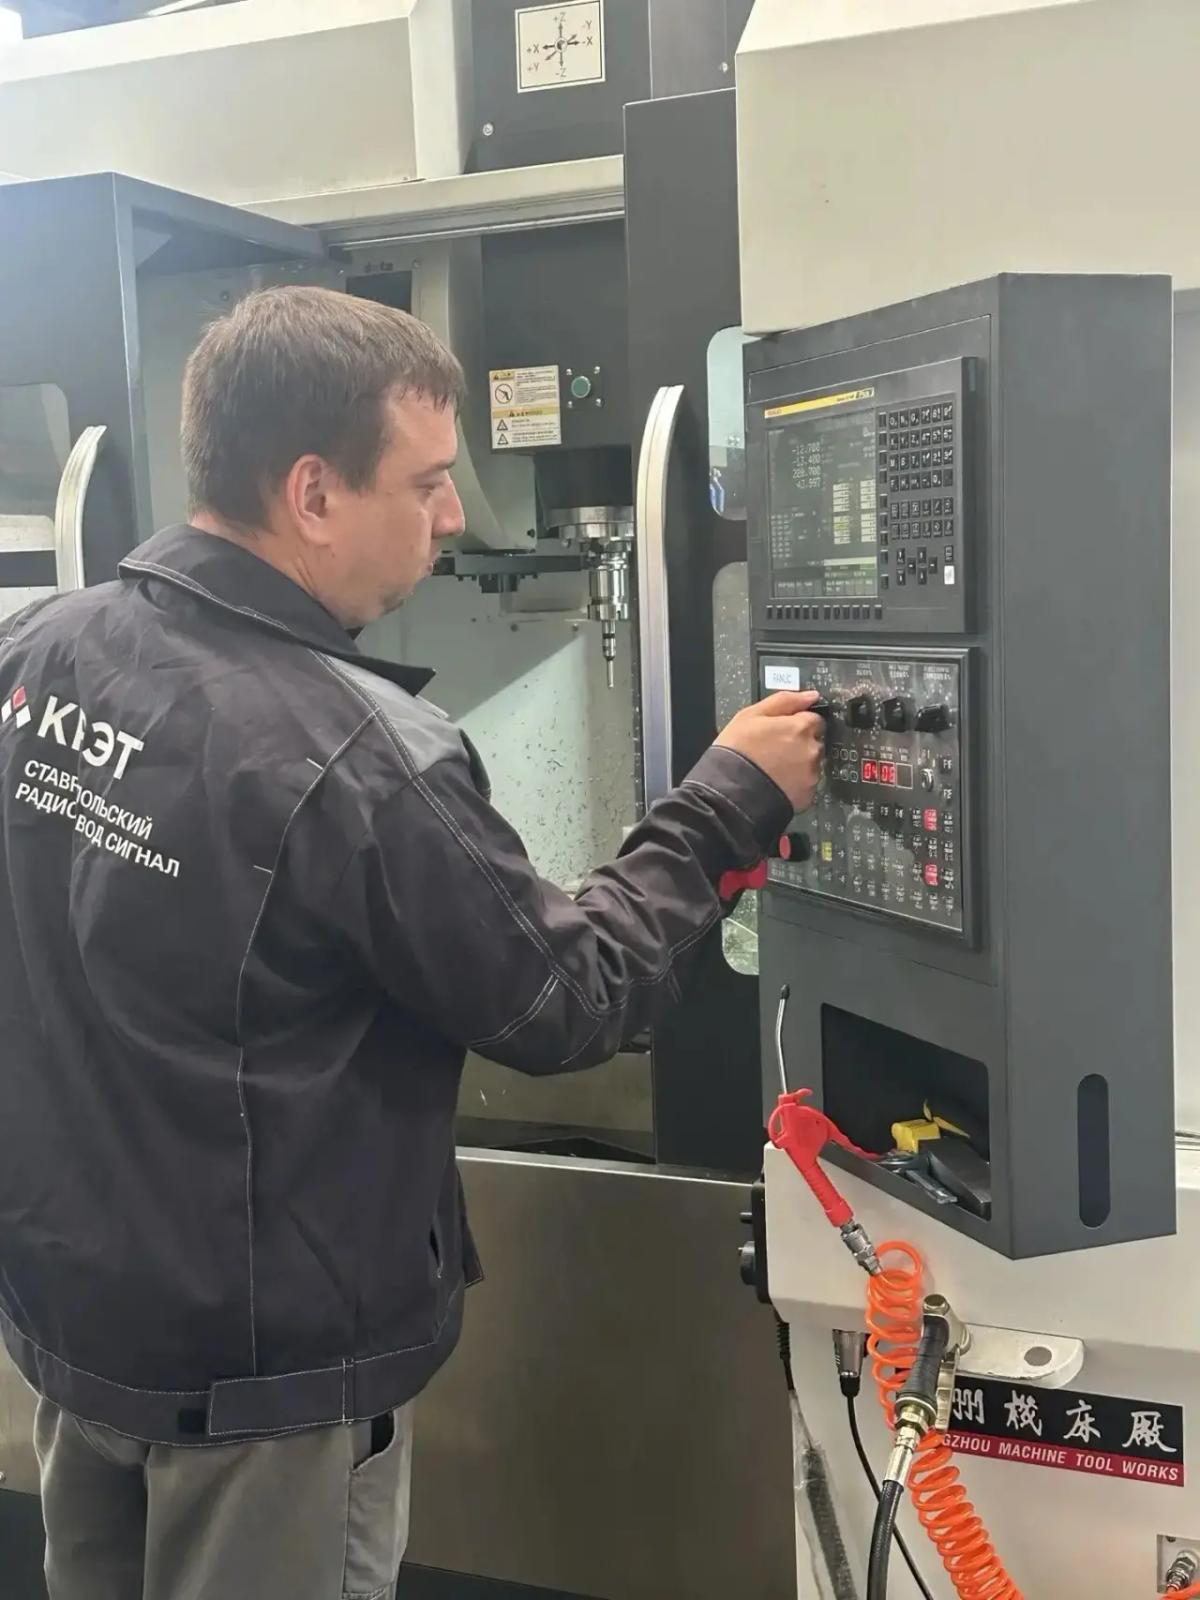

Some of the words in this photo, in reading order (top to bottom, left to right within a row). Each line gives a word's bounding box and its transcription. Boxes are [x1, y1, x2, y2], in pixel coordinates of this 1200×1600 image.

[526, 44, 540, 54] +X
[581, 36, 593, 46] -X
[24, 760, 153, 840] СТАВРПОЛЬСКИЙ
[105, 832, 181, 878] СИГНАЛ
[942, 1433, 991, 1452] GZHOU
[998, 1442, 1067, 1464] MACHINE
[1076, 1453, 1113, 1472] TOOL
[1122, 1460, 1179, 1481] WORKS
